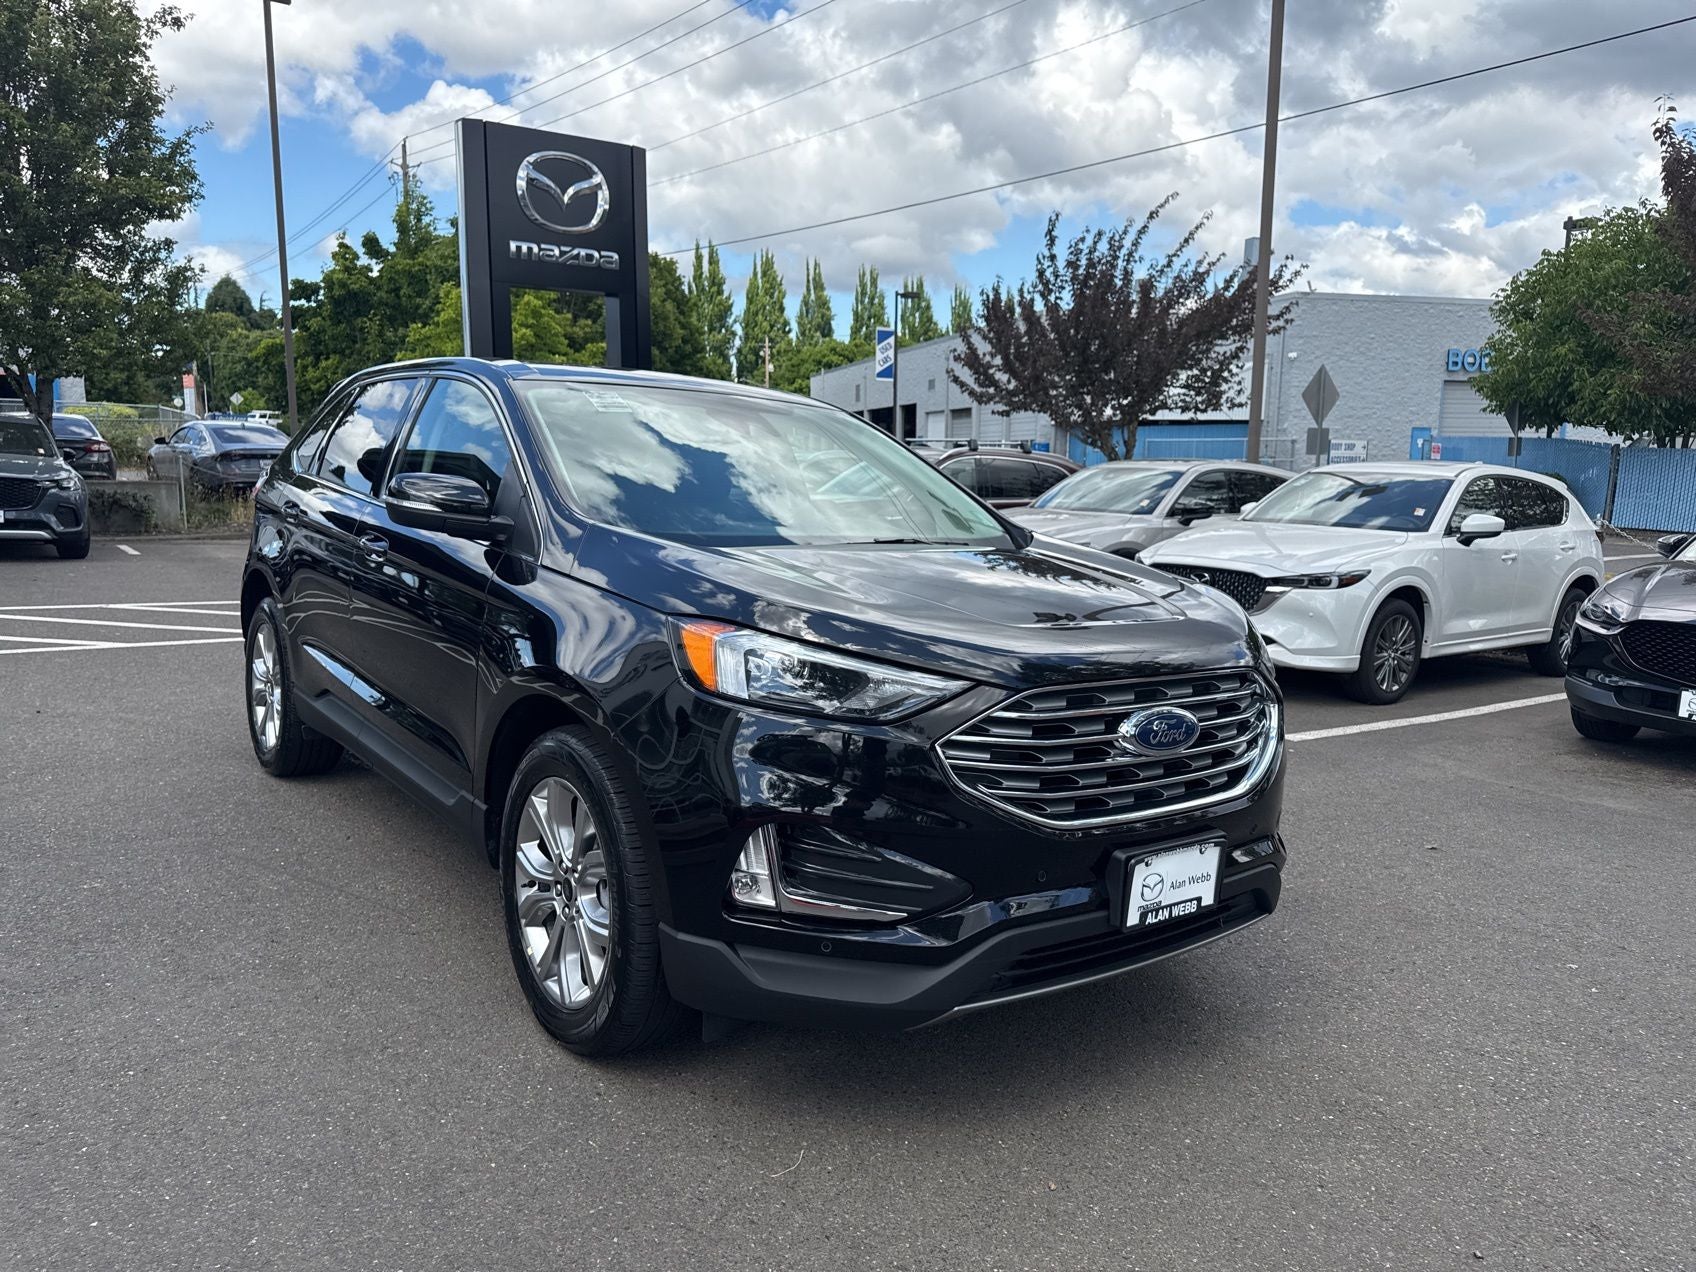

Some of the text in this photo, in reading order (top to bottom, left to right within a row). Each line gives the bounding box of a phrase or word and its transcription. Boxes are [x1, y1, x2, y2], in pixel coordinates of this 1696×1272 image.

[509, 240, 620, 270] mazda
[878, 342, 893, 355] USED
[878, 355, 893, 367] CARS
[1147, 719, 1187, 744] Ford
[1168, 871, 1212, 891] Alan Webb
[1145, 900, 1198, 925] ALAN WEBB
